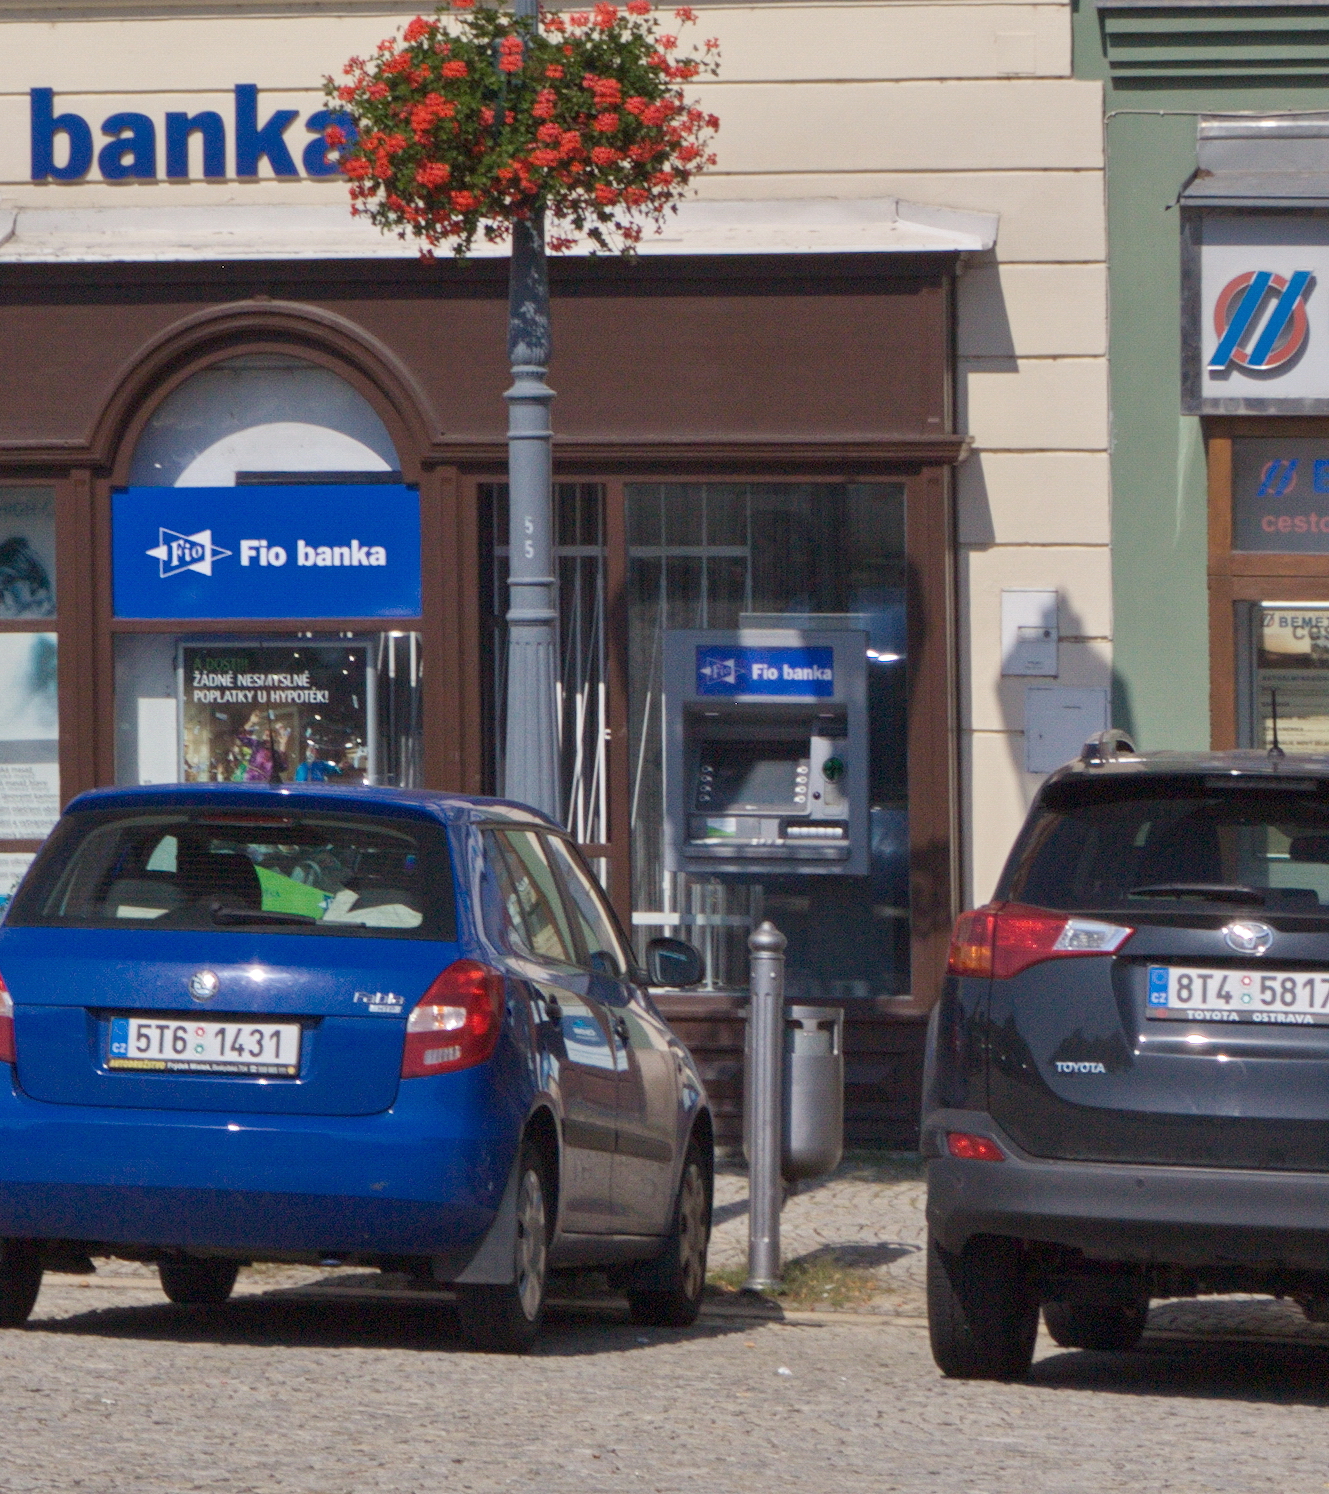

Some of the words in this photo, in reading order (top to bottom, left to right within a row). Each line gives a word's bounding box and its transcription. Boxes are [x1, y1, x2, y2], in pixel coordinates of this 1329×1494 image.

[30, 83, 359, 181] banka
[170, 538, 204, 567] Fio
[240, 539, 287, 566] Fio
[297, 539, 387, 566] banka
[193, 670, 234, 687] ŽÁDNÉ
[237, 670, 311, 687] NESMYSLNÉ
[752, 663, 778, 680] Fio
[783, 664, 833, 681] banka
[194, 690, 254, 703] POPLATKY
[258, 690, 267, 703] U
[1151, 993, 1167, 1003] CZ
[1176, 974, 1233, 1005] 8T4
[1186, 1010, 1240, 1022] TOYOTA
[1252, 1012, 1314, 1024] OSTRAVA
[112, 1043, 127, 1053] CZ
[135, 1024, 188, 1055] 5T6
[214, 1028, 283, 1059] 1431
[1055, 1062, 1106, 1074] TOYOTA
